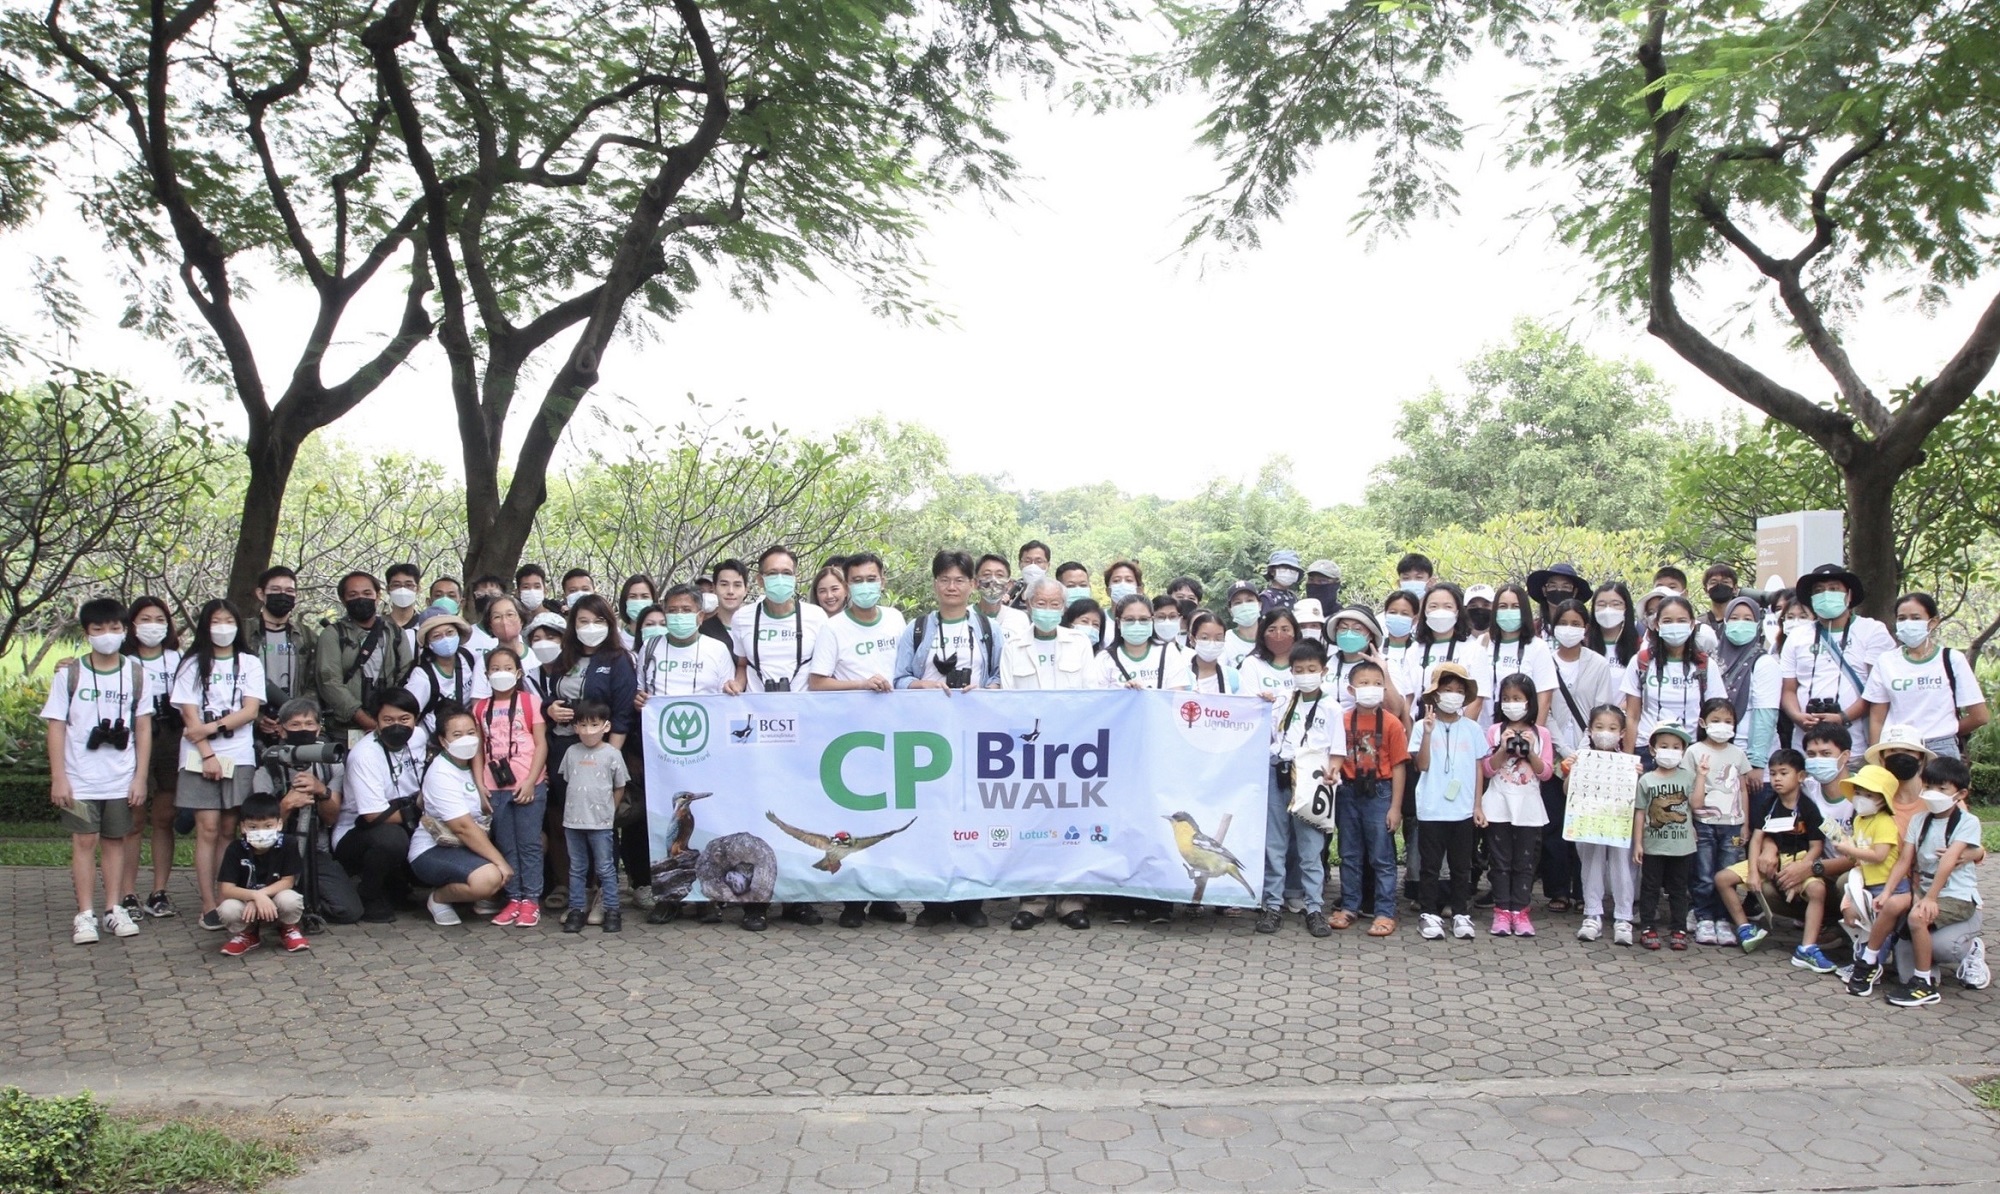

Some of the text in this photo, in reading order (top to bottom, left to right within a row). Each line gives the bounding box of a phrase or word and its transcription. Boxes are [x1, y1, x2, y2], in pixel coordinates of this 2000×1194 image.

[758, 629, 778, 641] CP
[855, 636, 896, 655] CP Bird
[657, 660, 704, 672] CP Bird
[1262, 676, 1281, 688] CP
[1891, 676, 1943, 691] CP Bird
[105, 690, 129, 701] Bird
[1204, 707, 1230, 718] true
[760, 719, 795, 731] BCST
[819, 729, 1110, 811] CP Bird
[977, 781, 1109, 810] WALK
[953, 830, 979, 841] true
[1019, 829, 1058, 840] Lotus's
